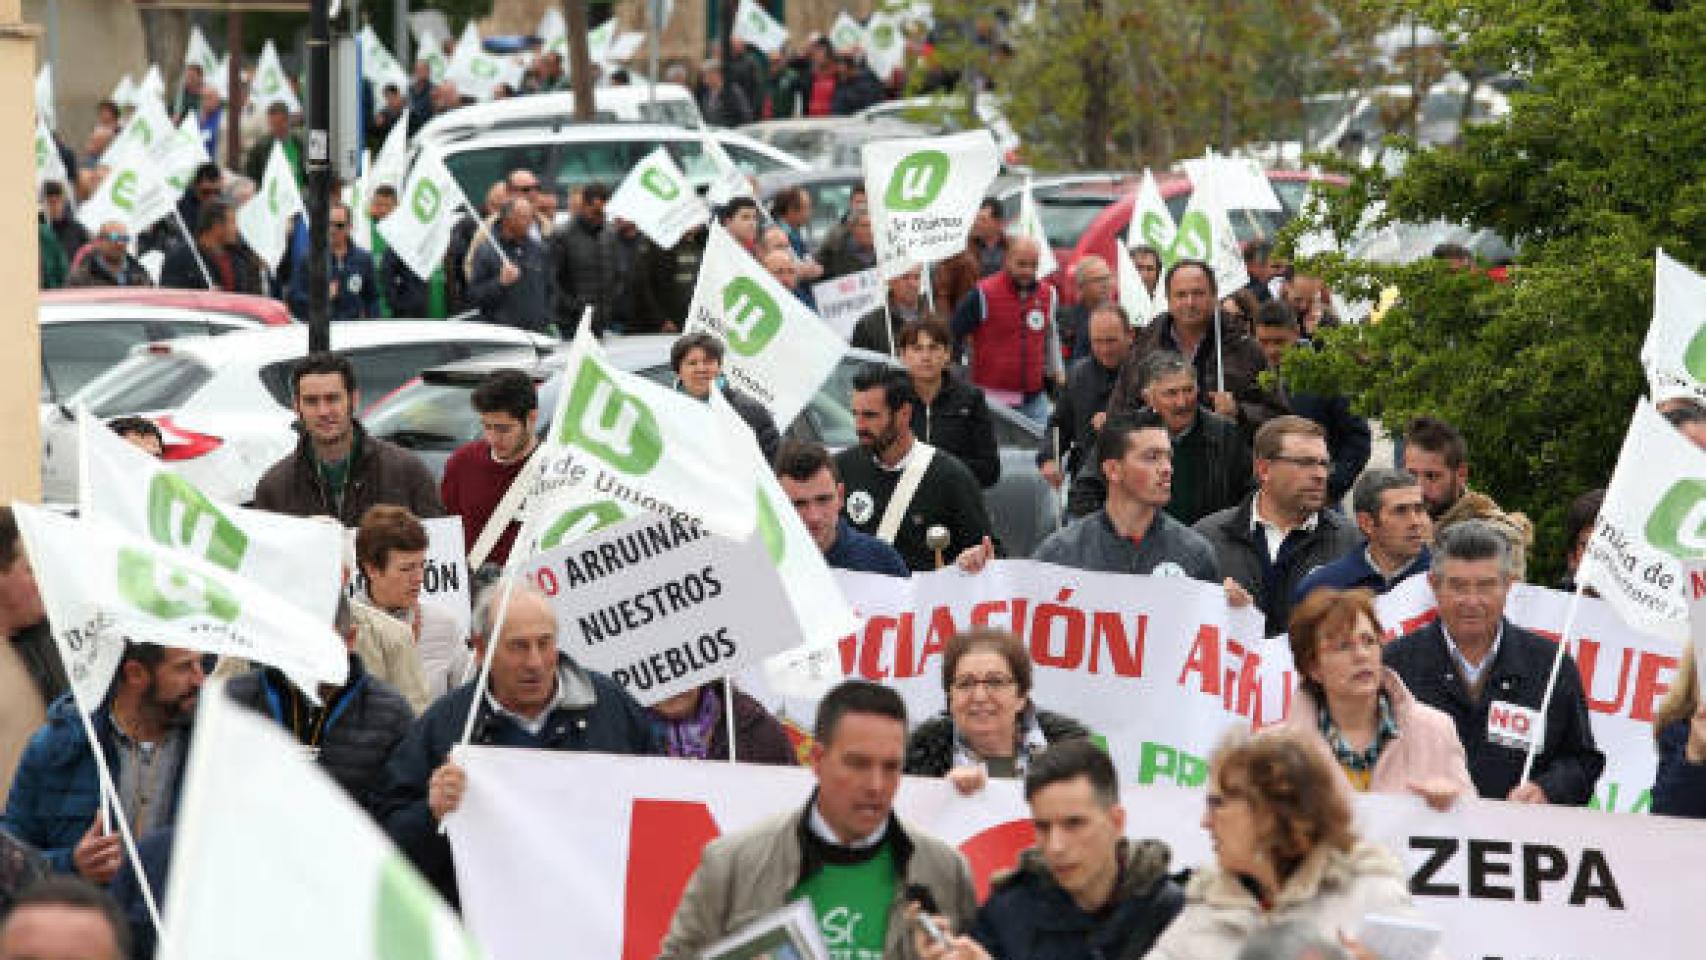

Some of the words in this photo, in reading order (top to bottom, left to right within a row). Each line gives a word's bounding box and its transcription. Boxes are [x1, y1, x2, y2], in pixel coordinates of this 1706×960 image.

[578, 564, 722, 646] NUESTROS
[1643, 561, 1675, 591] de
[611, 626, 737, 690] PUEBLOS
[1490, 707, 1530, 736] NO
[1407, 835, 1626, 911] ZEPA
